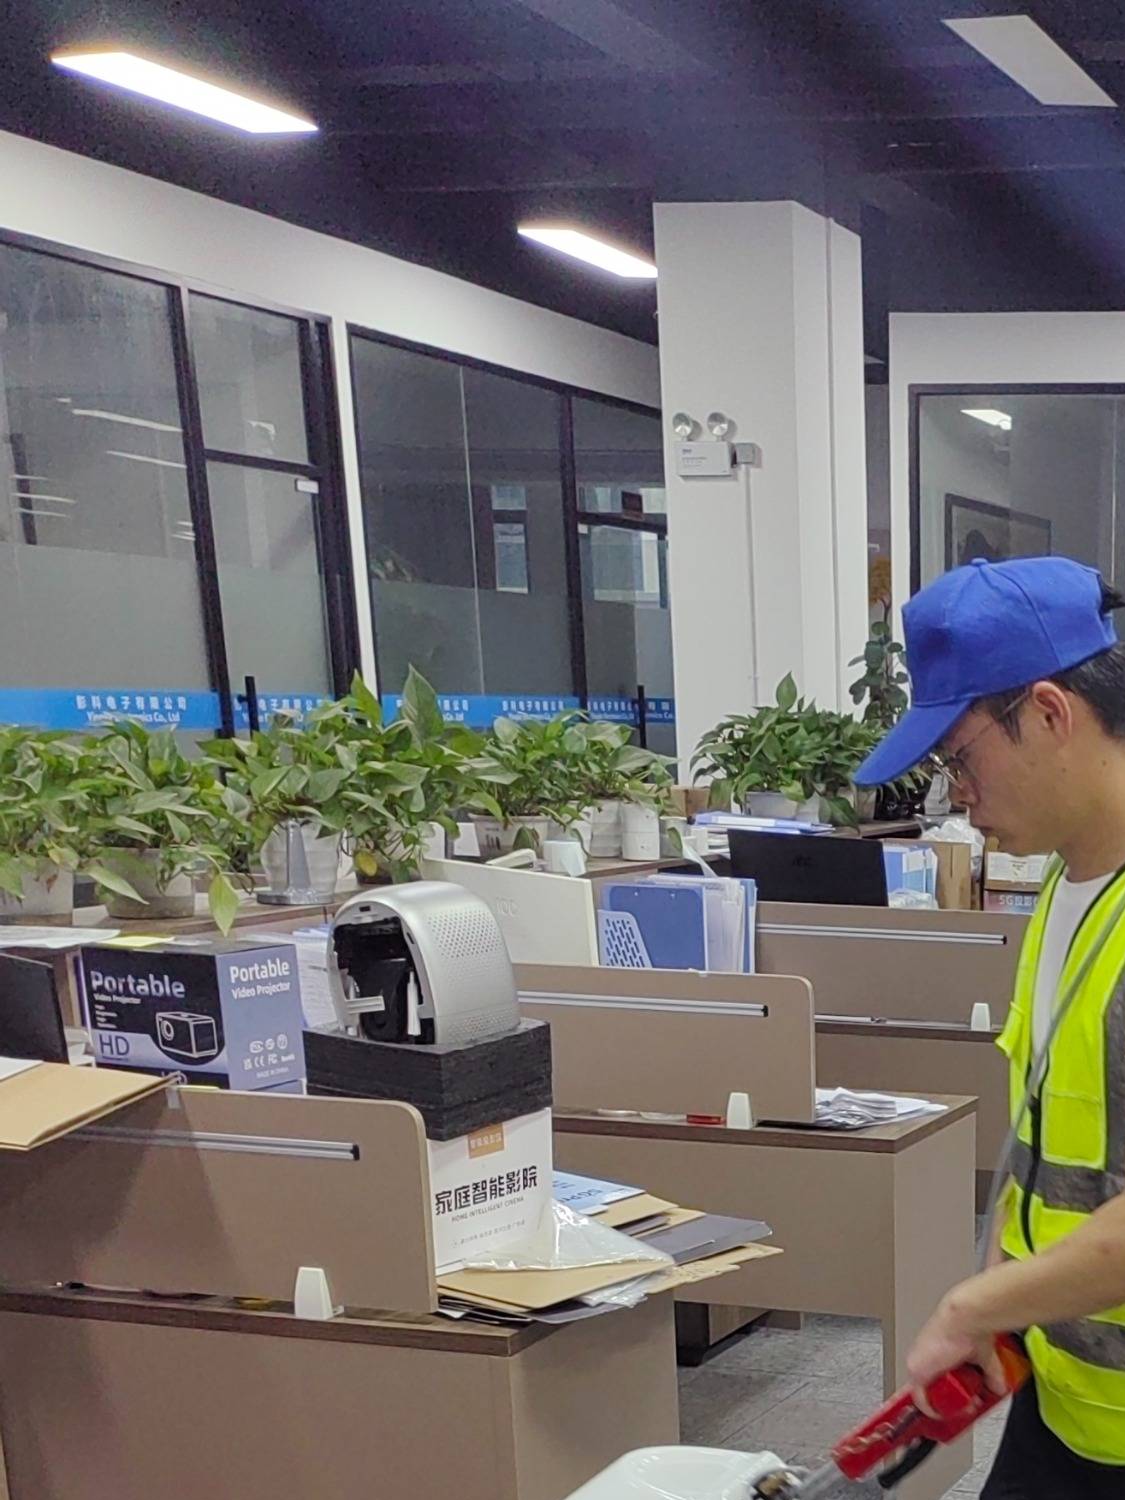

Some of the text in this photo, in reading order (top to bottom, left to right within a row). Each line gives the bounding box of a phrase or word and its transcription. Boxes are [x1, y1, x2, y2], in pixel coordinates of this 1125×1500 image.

[230, 958, 290, 984] Portable
[91, 972, 186, 998] Portable
[231, 981, 291, 1000] Video Projector
[99, 1033, 130, 1056] HD
[435, 1165, 538, 1216] 家庭智能影院
